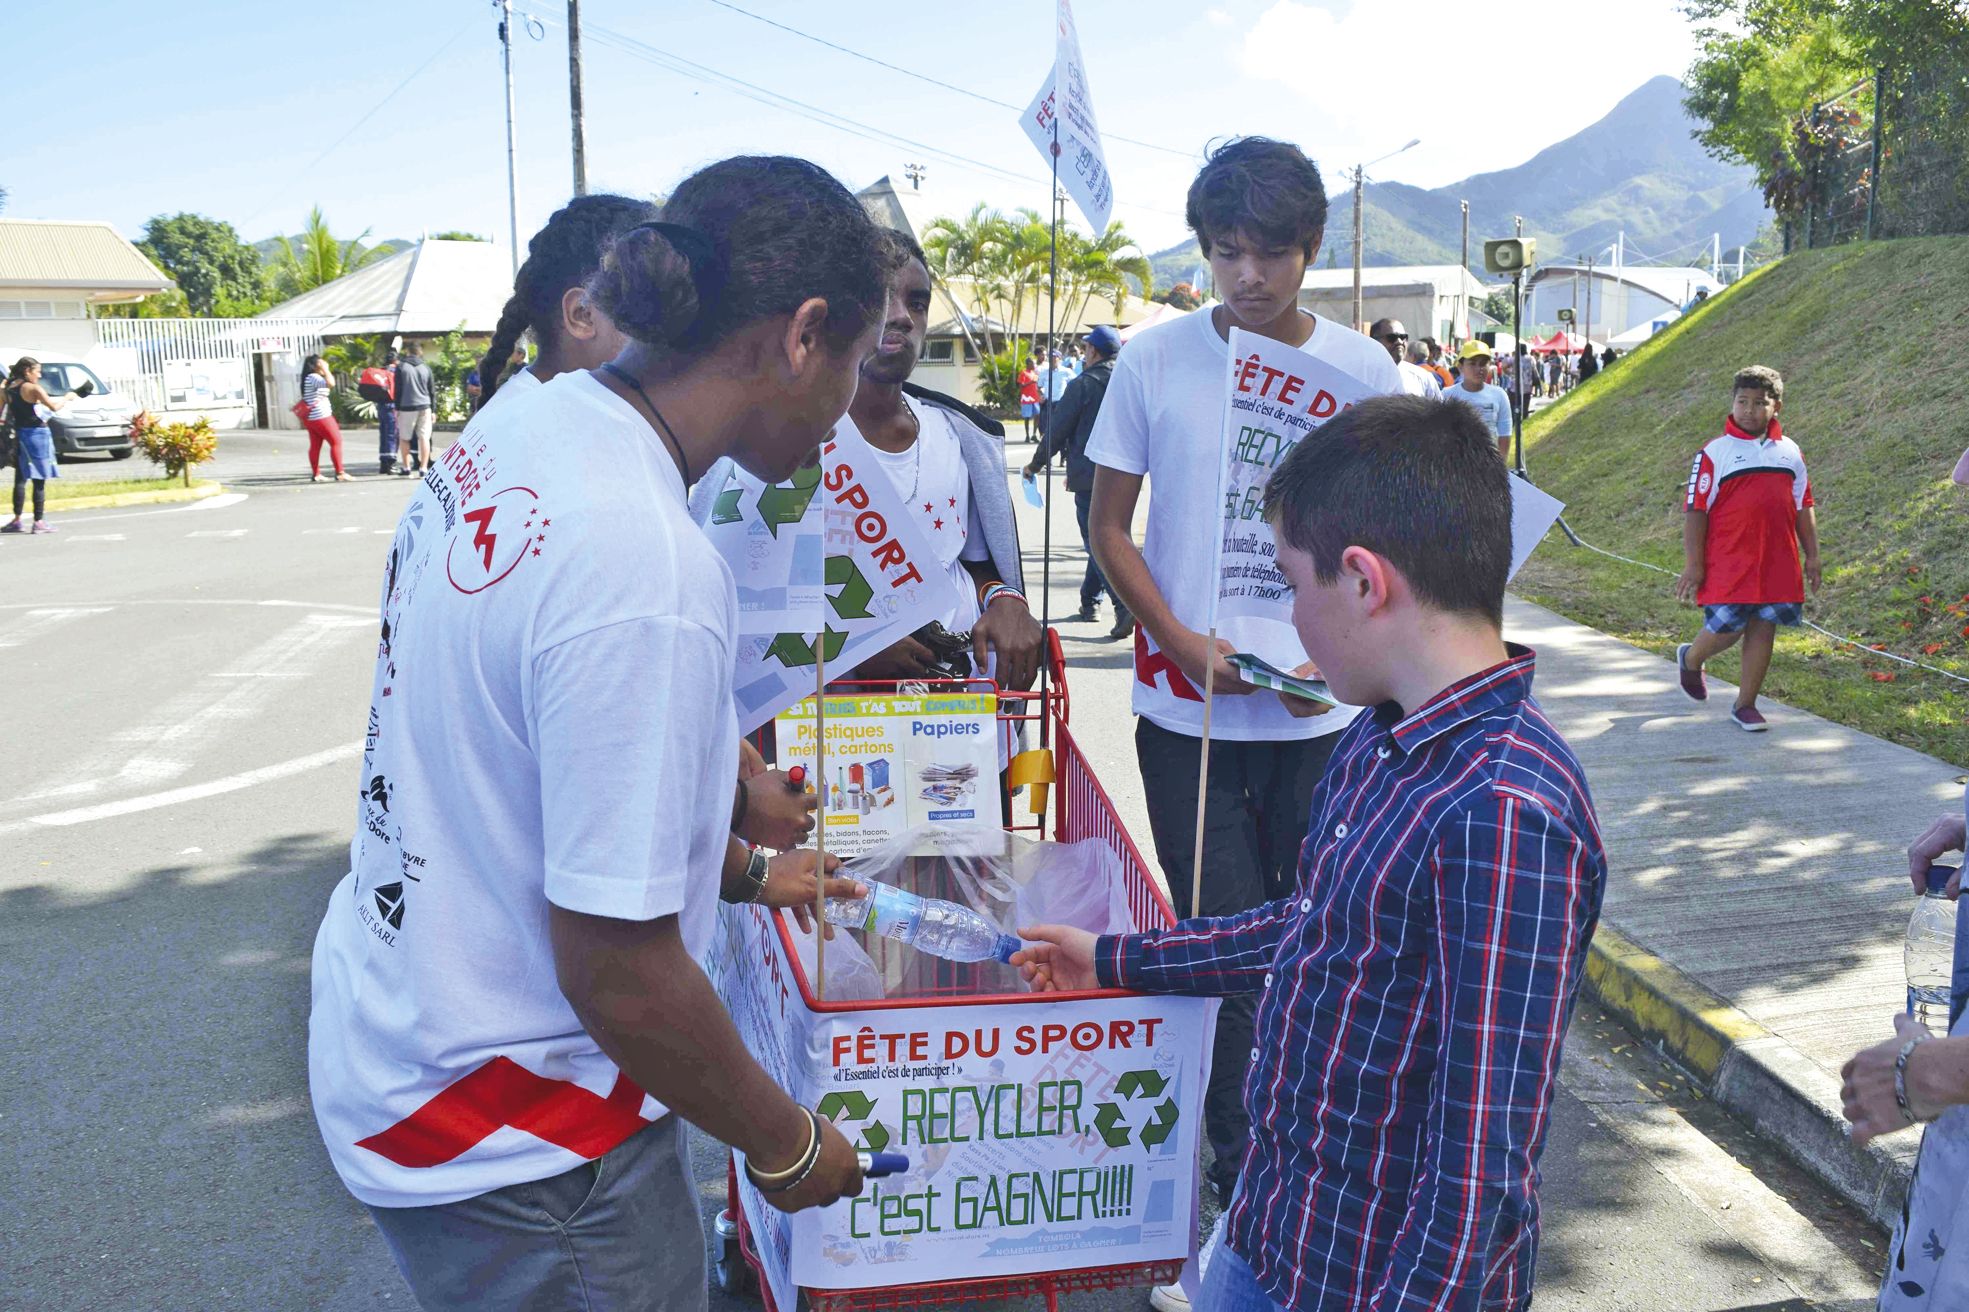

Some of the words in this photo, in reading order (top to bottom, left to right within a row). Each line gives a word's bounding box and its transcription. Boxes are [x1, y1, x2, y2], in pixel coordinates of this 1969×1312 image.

[1274, 407, 1283, 420] de
[824, 464, 924, 589] SPORT
[1242, 562, 1251, 577] de
[892, 700, 921, 713] TOUT
[912, 720, 980, 739] Papiers
[839, 741, 895, 755] cartons
[862, 828, 890, 837] flacons,
[371, 922, 398, 948] SARL
[832, 1026, 928, 1067] FÊTE
[944, 1027, 999, 1060] DU
[1013, 1018, 1163, 1056] SPORT
[900, 1064, 910, 1078] de
[912, 1062, 949, 1080] participer
[902, 1079, 1090, 1146] RECYCLER,
[954, 1164, 1133, 1230] GAGNER!!!!
